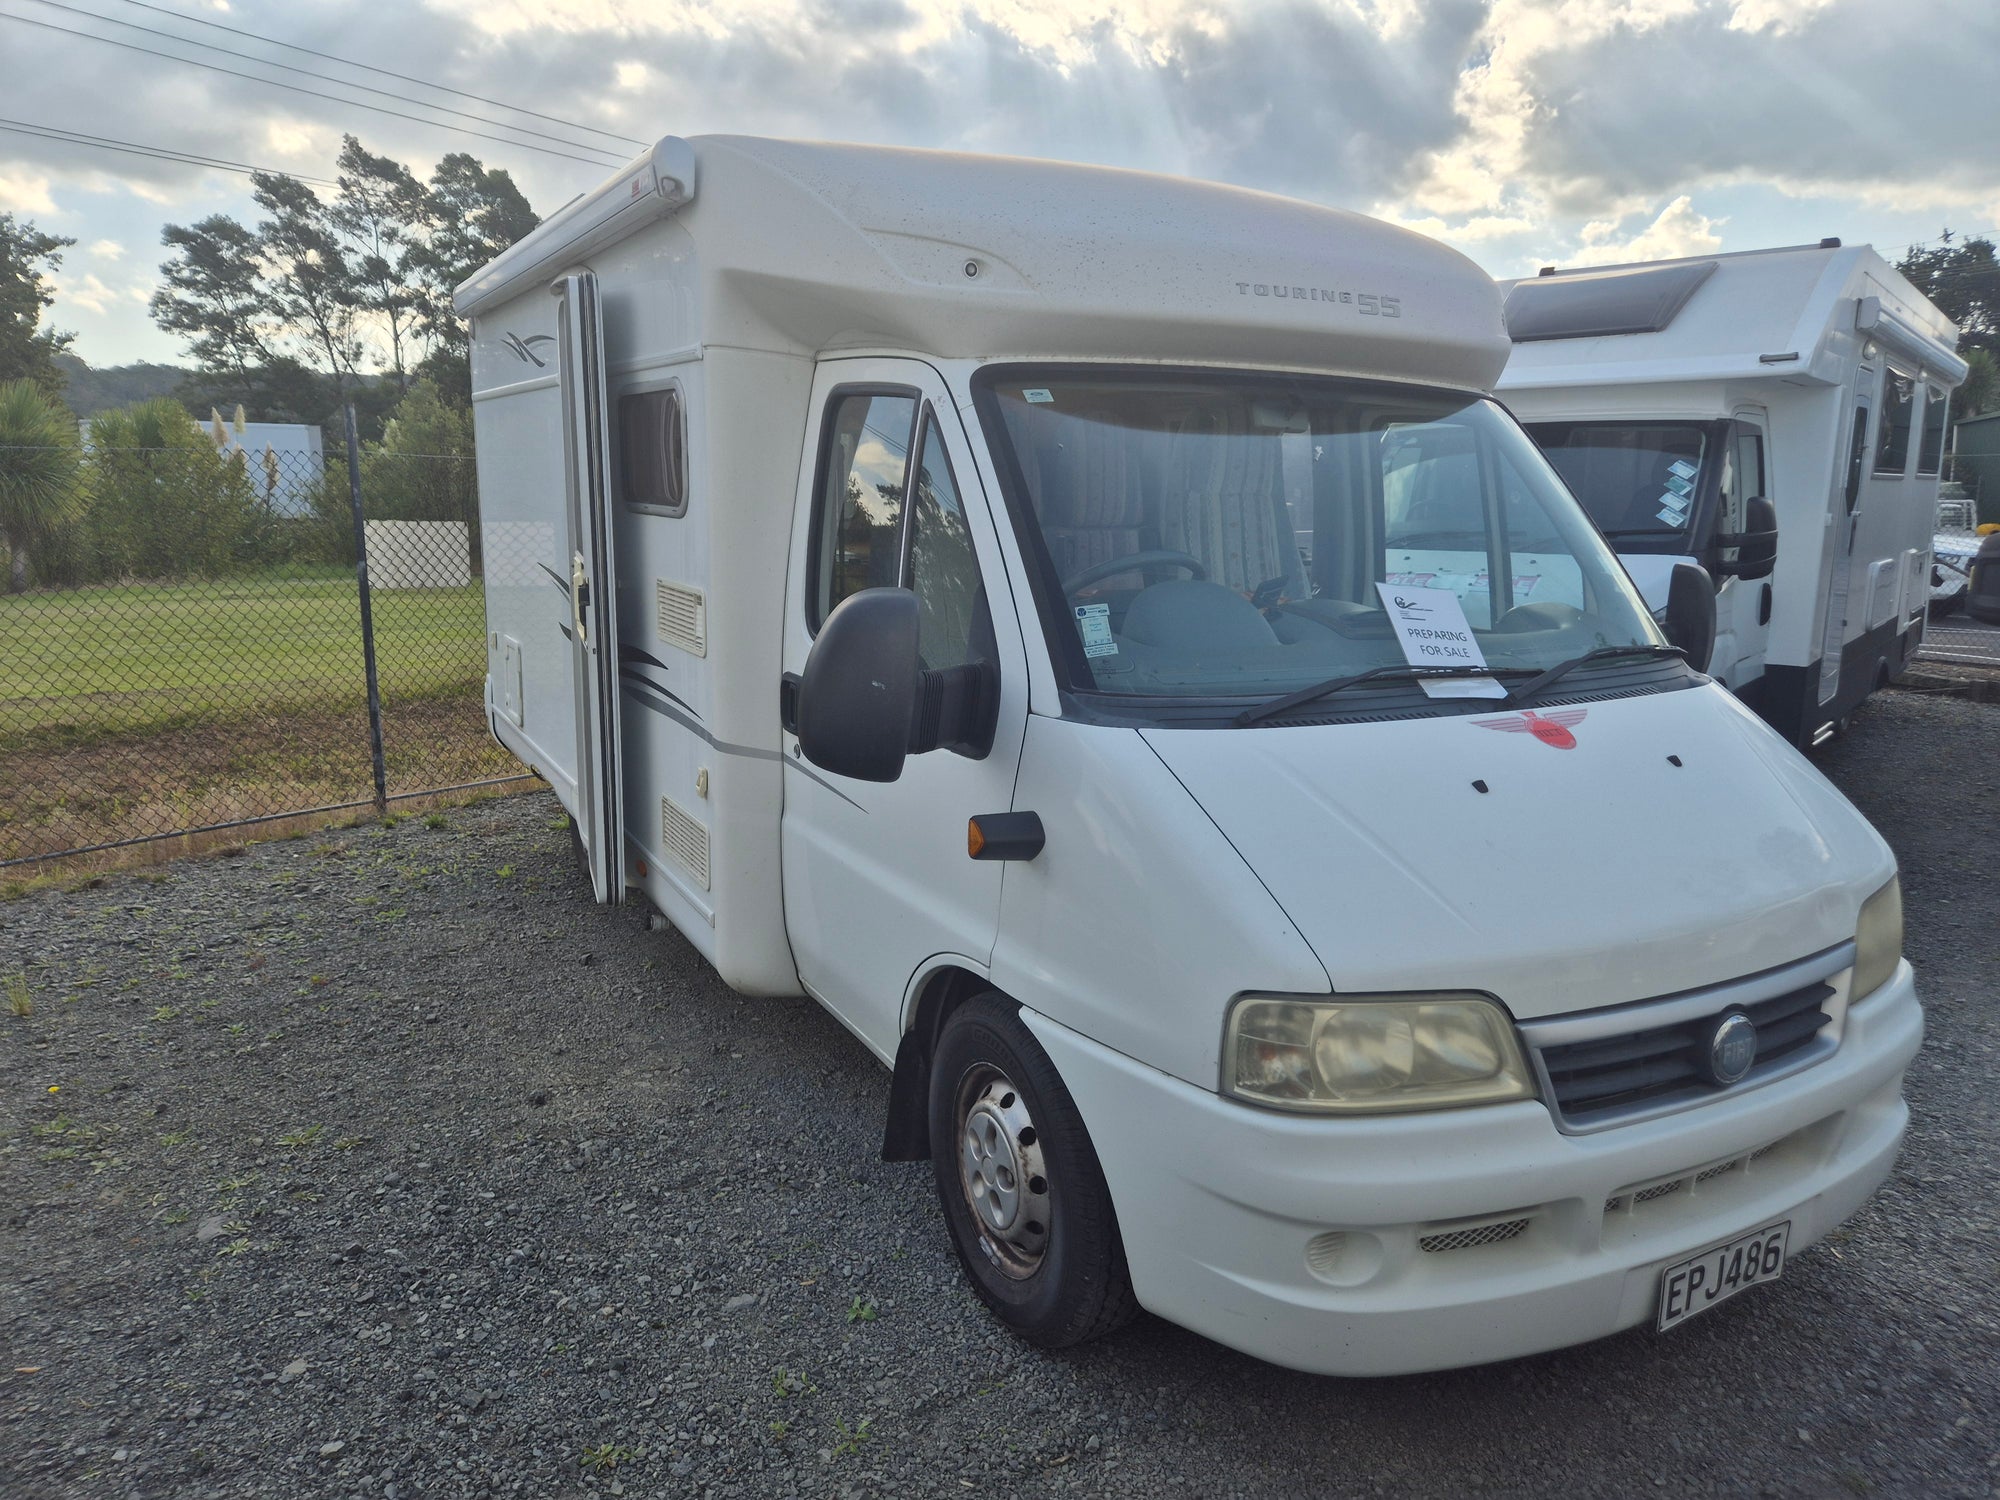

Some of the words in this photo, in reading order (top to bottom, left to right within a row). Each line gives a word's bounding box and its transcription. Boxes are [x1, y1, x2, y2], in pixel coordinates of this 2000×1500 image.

[1235, 282, 1352, 304] TOURING
[1357, 293, 1401, 318] 55
[1407, 628, 1468, 642] PREPARING
[1420, 645, 1443, 656] FOR
[1444, 646, 1470, 658] SALE
[1723, 1037, 1753, 1065] FIAT
[1665, 1232, 1782, 1321] EPJ486
